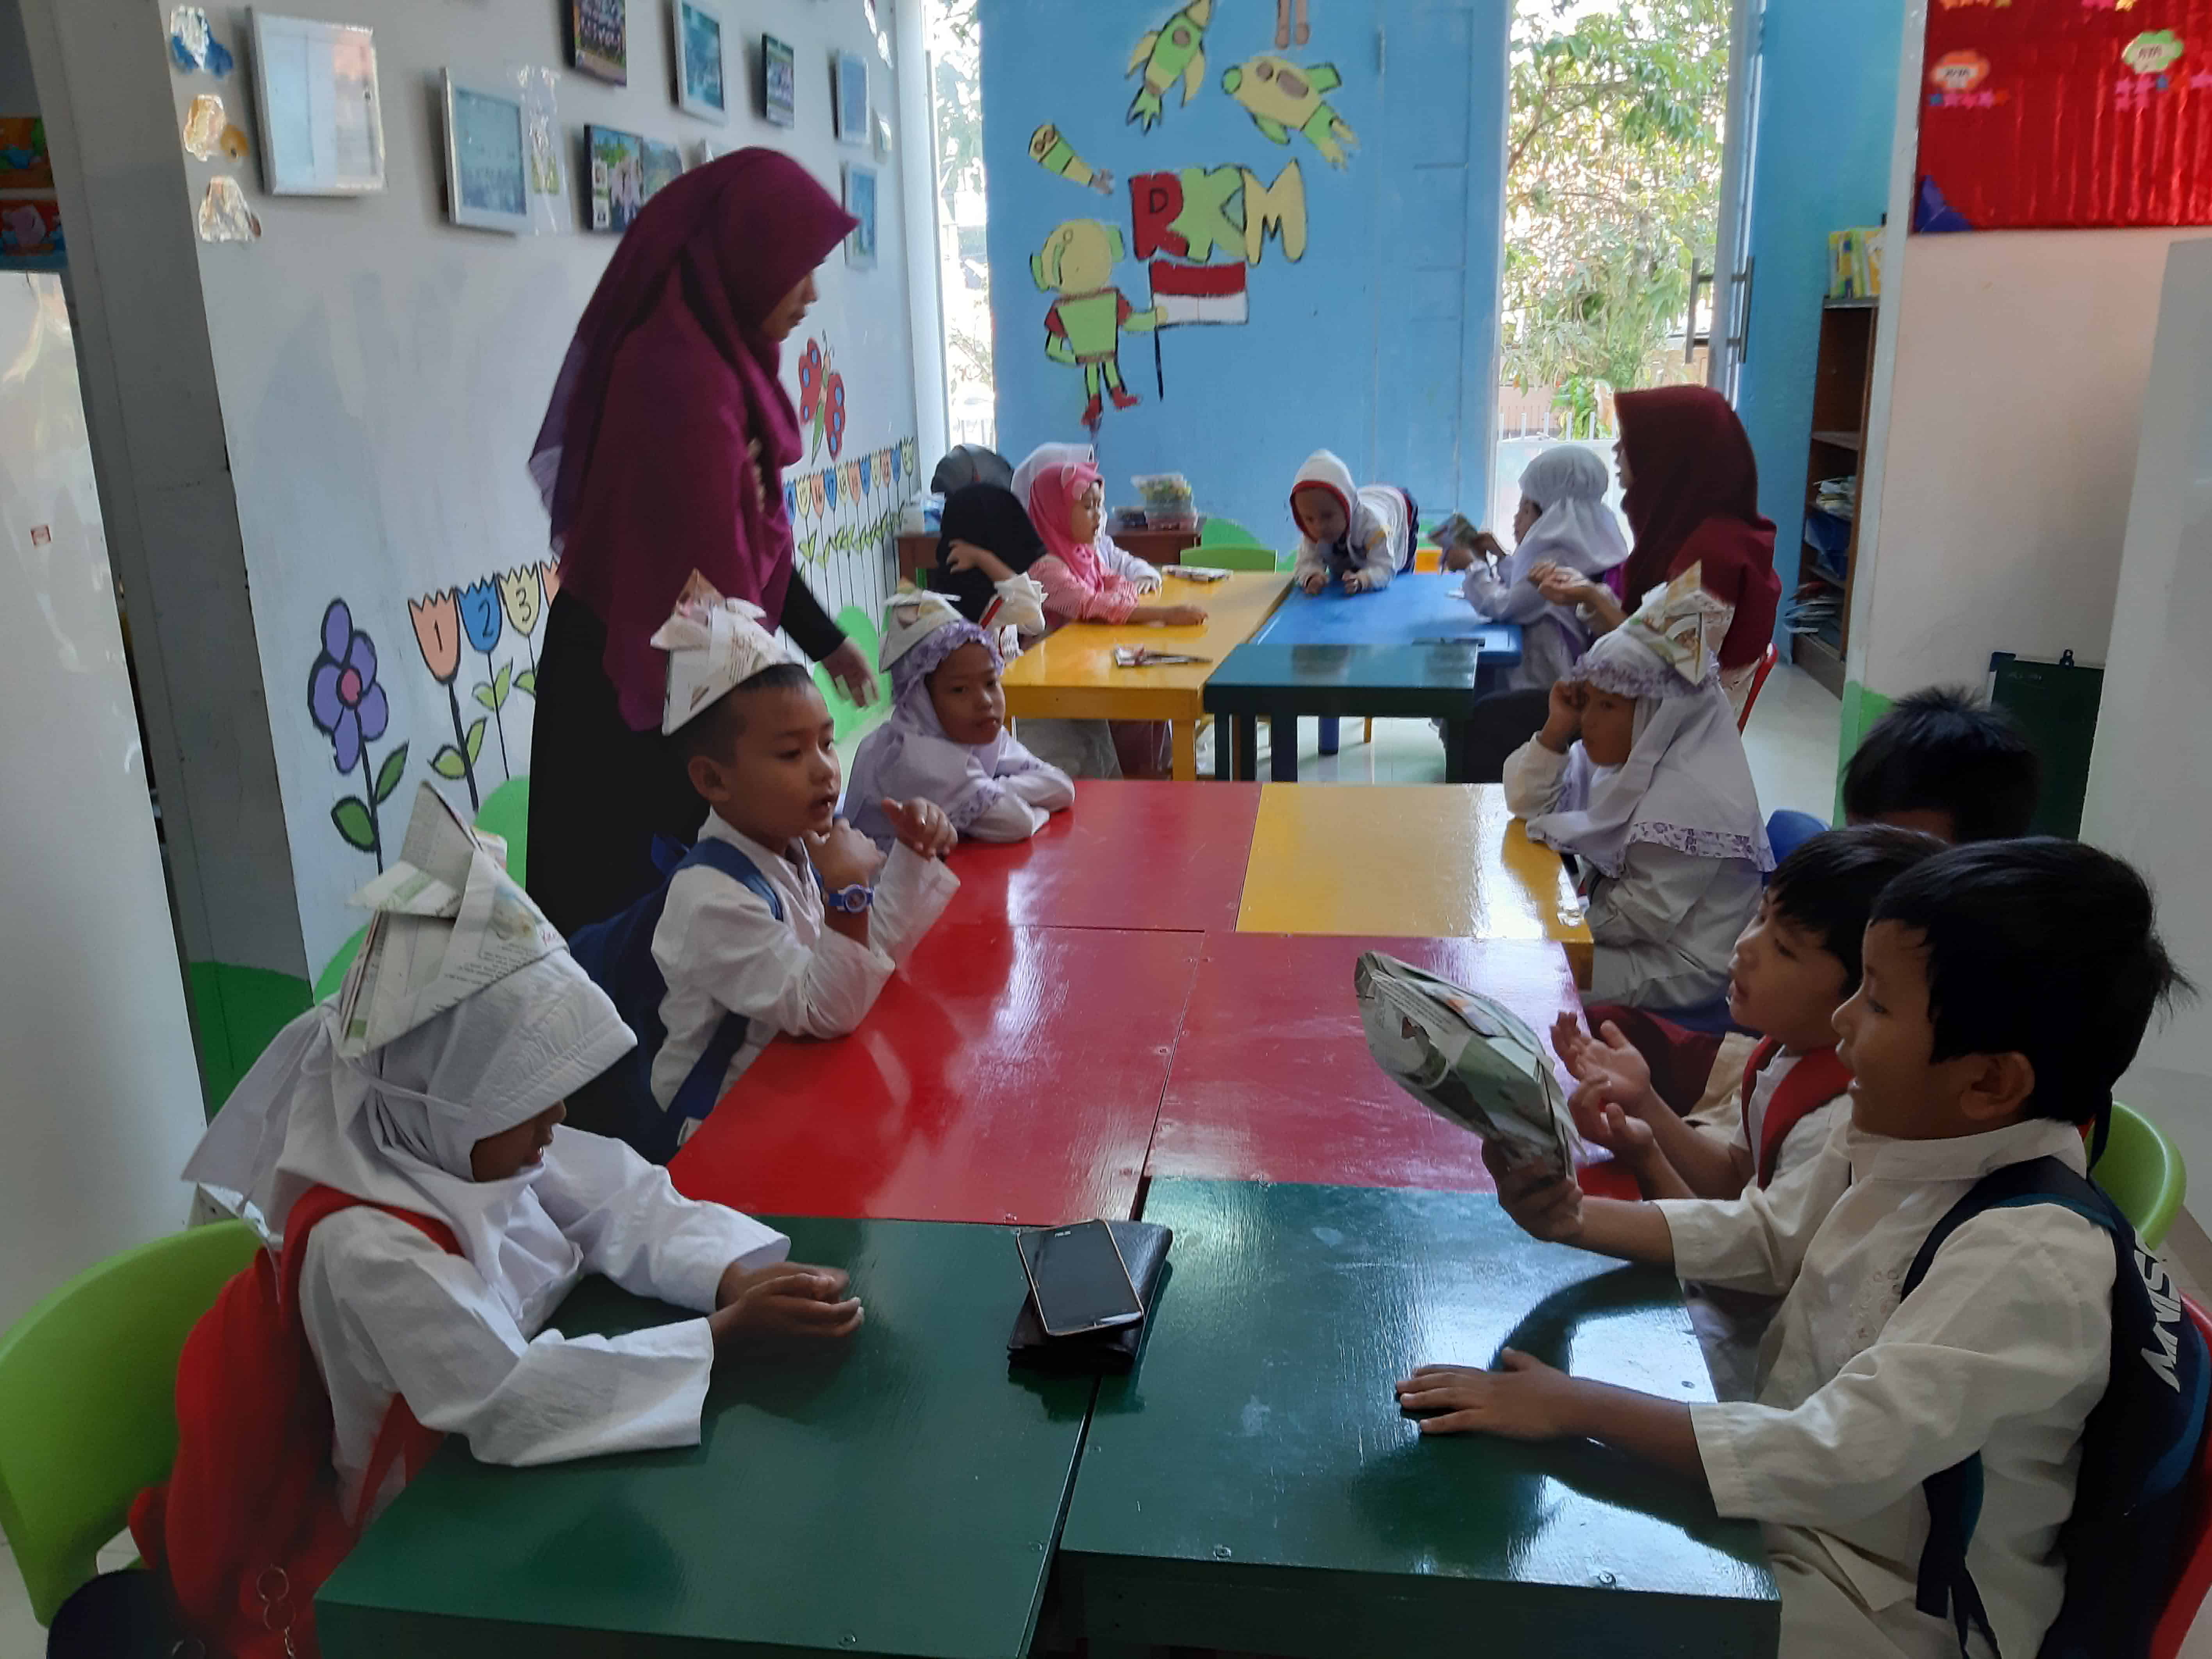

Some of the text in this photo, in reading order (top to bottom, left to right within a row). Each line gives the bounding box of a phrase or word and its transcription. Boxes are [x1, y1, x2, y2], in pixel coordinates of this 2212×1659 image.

[1128, 156, 1307, 268] RKM
[434, 587, 531, 651] 1 2 3
